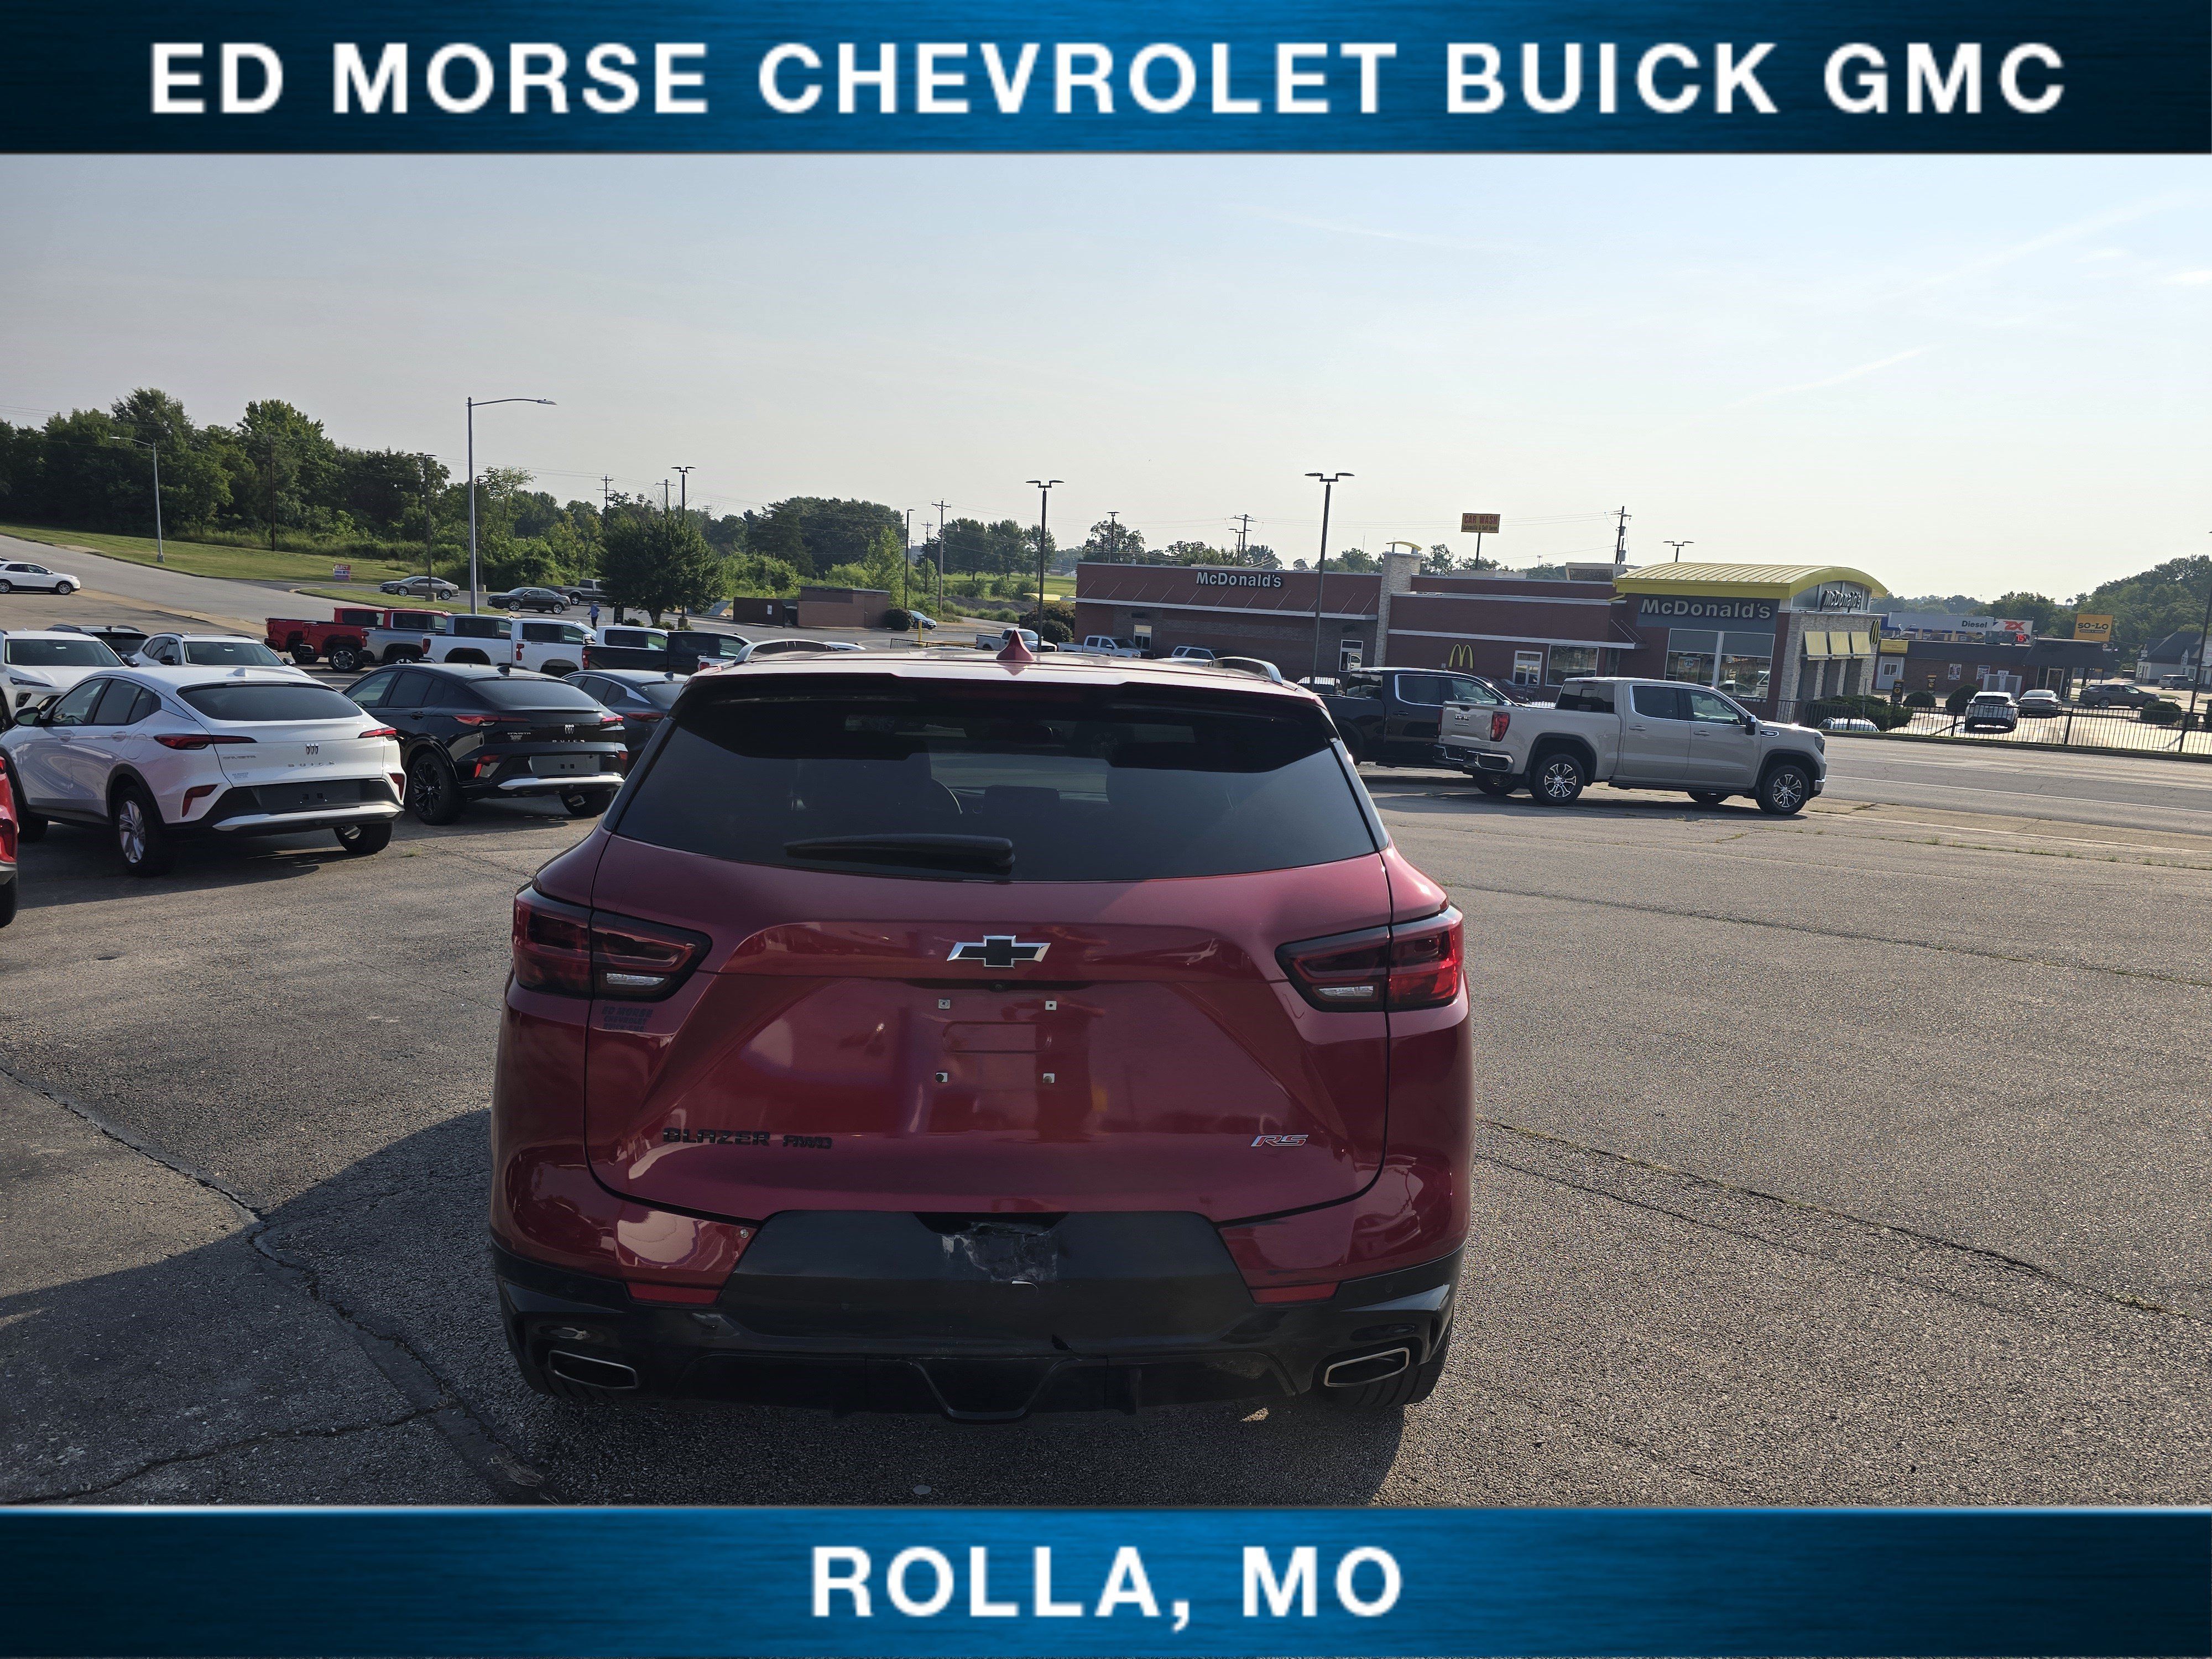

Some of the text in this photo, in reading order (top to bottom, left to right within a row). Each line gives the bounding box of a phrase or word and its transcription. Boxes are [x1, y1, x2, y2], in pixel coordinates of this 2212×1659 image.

[1464, 515, 1498, 524] CAR WASH
[1196, 572, 1281, 588] McDonald's
[1823, 589, 1861, 607] McDonald's
[1640, 599, 1771, 619] McDonald's
[1961, 620, 1988, 628] Diesel
[662, 1127, 833, 1149] BLAZER AWD
[1250, 1135, 1309, 1147] RS
